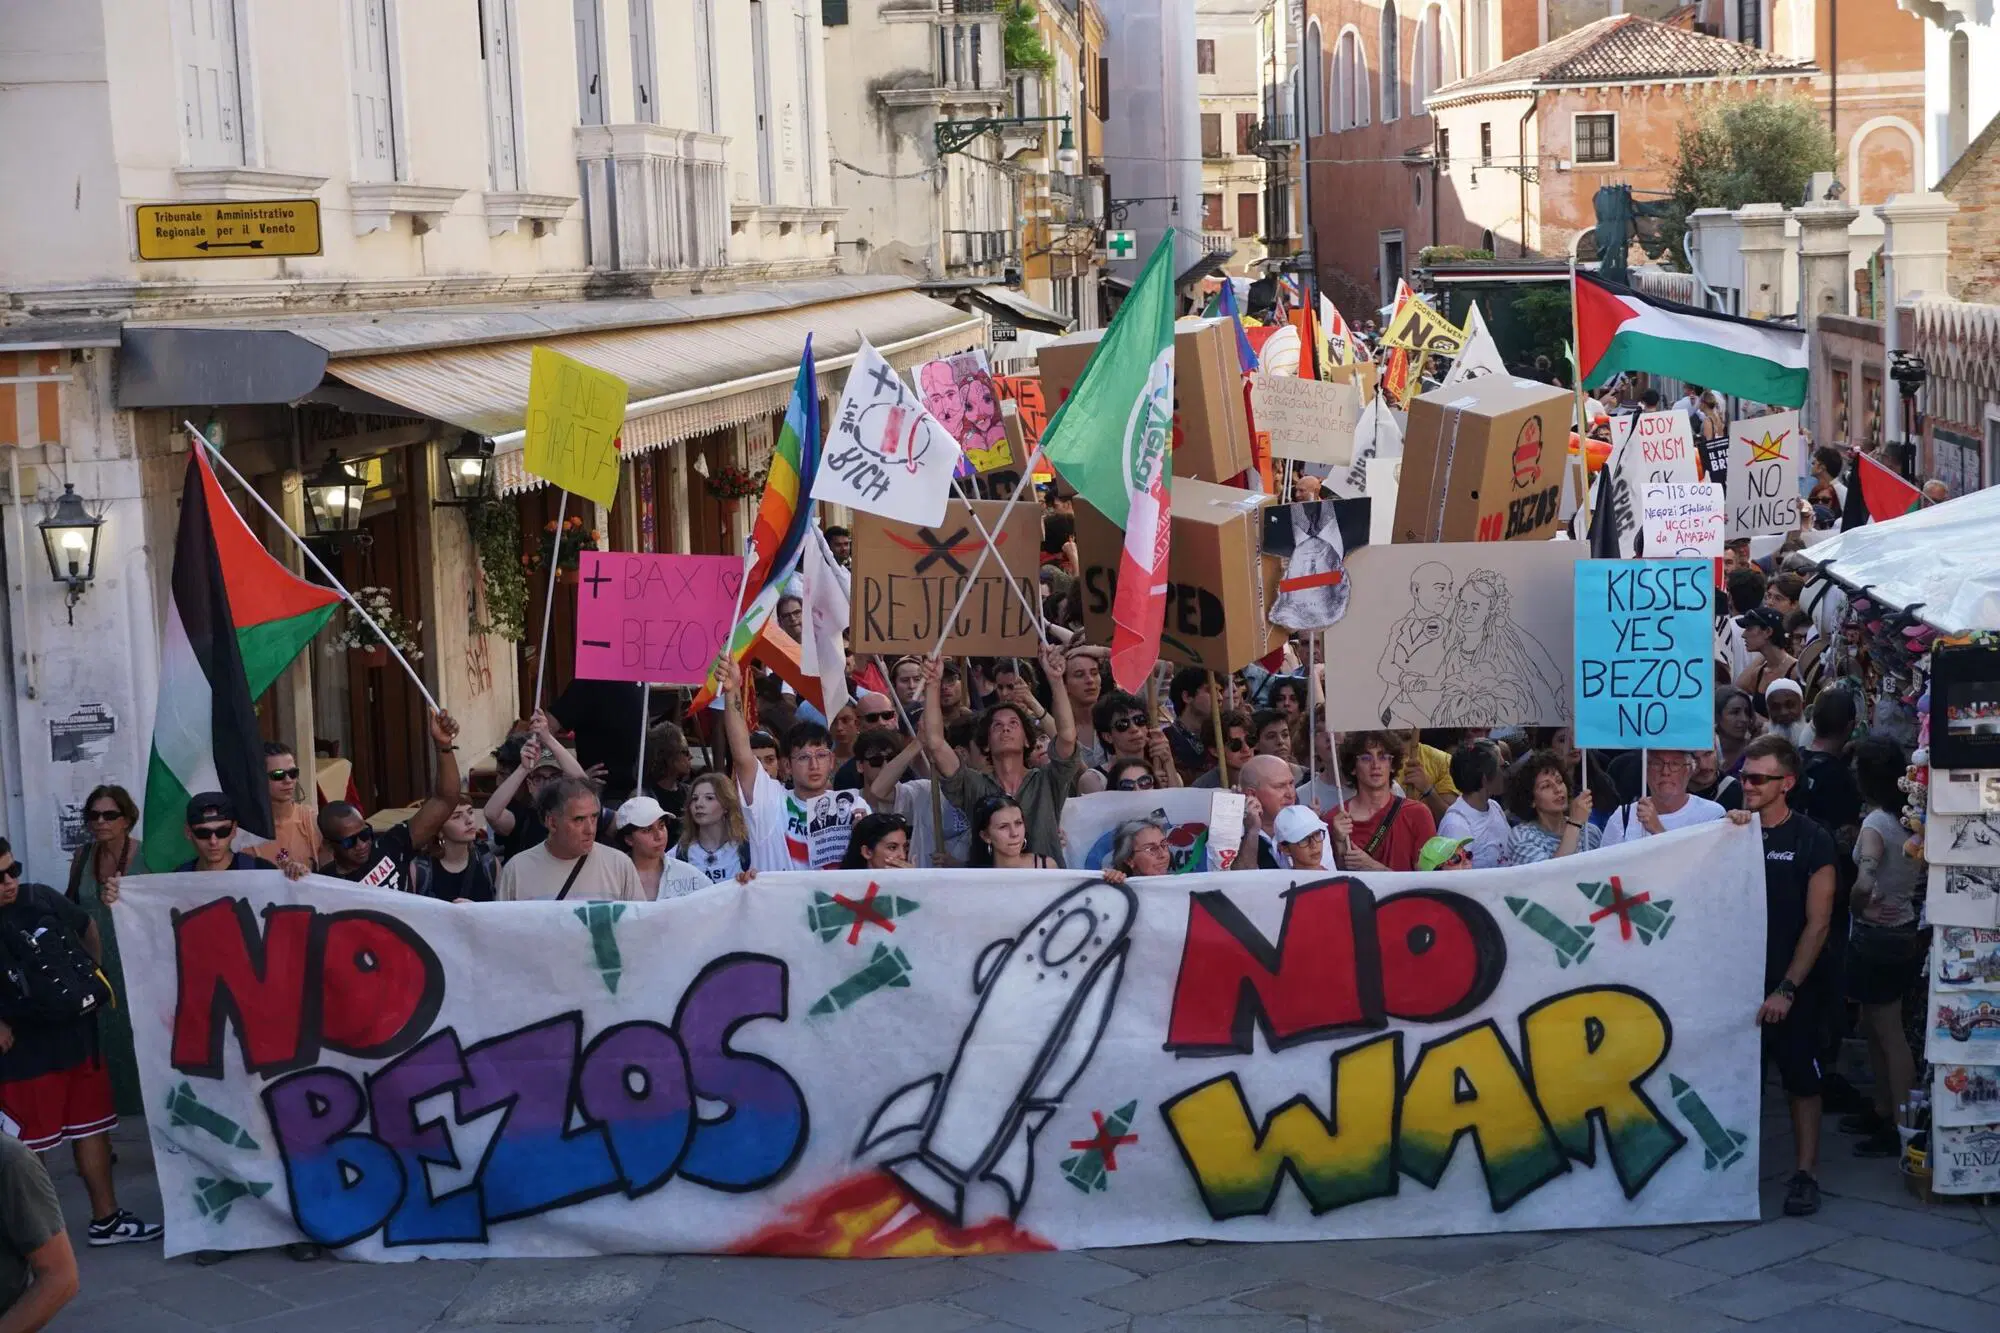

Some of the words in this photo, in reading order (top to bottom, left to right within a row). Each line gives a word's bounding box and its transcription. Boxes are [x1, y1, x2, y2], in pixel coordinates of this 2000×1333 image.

[155, 211, 202, 222] Tribunale
[216, 208, 294, 220] Amministrativo
[156, 226, 206, 239] Regionale
[217, 227, 233, 238] per
[243, 225, 249, 235] il
[259, 223, 296, 234] Veneto
[993, 330, 1016, 338] LOTTO
[1271, 428, 1321, 446] ENEZIA
[1748, 464, 1782, 500] NO
[1735, 497, 1799, 532] KINGS
[1608, 566, 1707, 612] KISSES
[864, 574, 1037, 642] REJECTED
[1611, 616, 1674, 653] YES
[1582, 658, 1703, 699] BEZOS
[1618, 702, 1668, 737] NO
[1163, 876, 1507, 1058] NO
[171, 896, 446, 1078] NO
[260, 951, 810, 1249] BEZOS
[1159, 983, 1688, 1221] WAR
